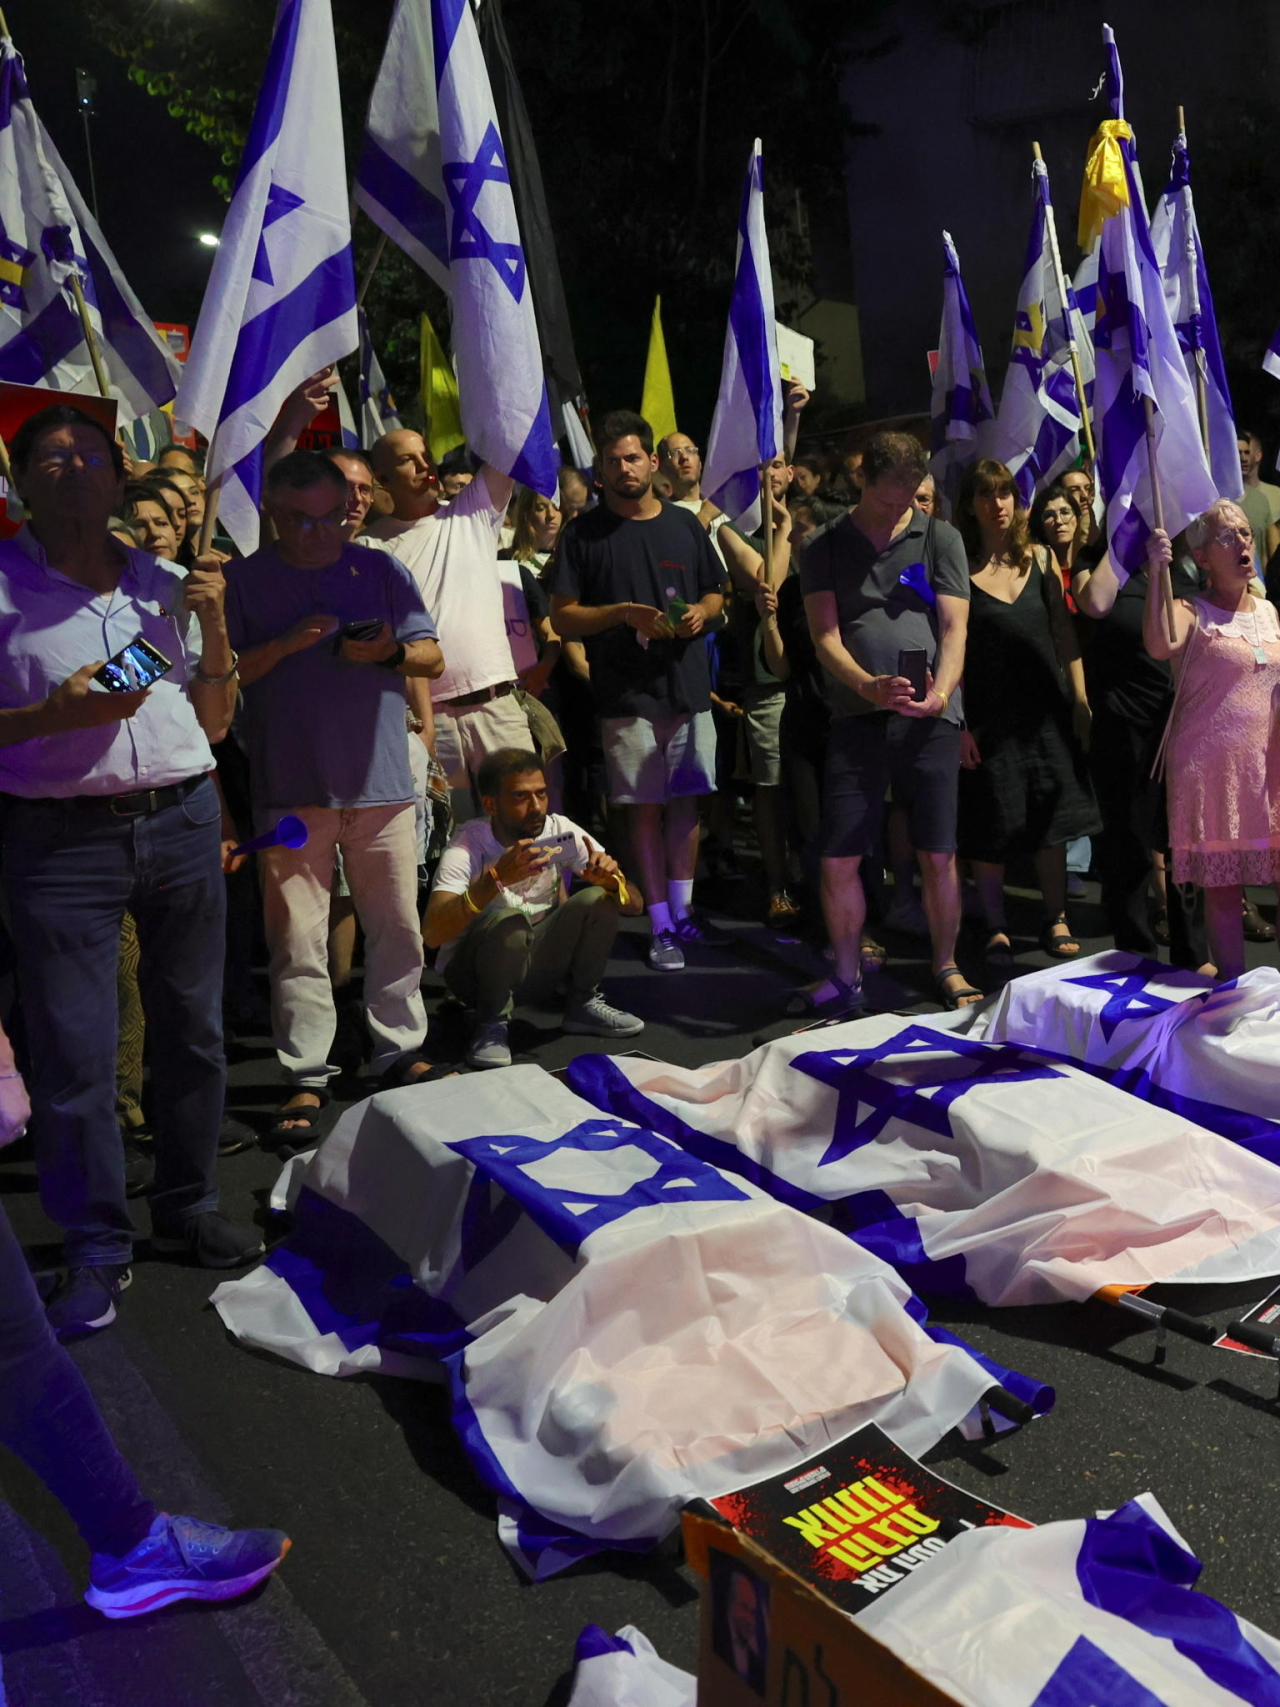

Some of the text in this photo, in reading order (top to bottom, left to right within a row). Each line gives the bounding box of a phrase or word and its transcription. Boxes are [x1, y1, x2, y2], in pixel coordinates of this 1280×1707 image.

[782, 1475, 906, 1549] אותנו
[826, 1503, 941, 1573] הרגת
[852, 1564, 905, 1594] את
